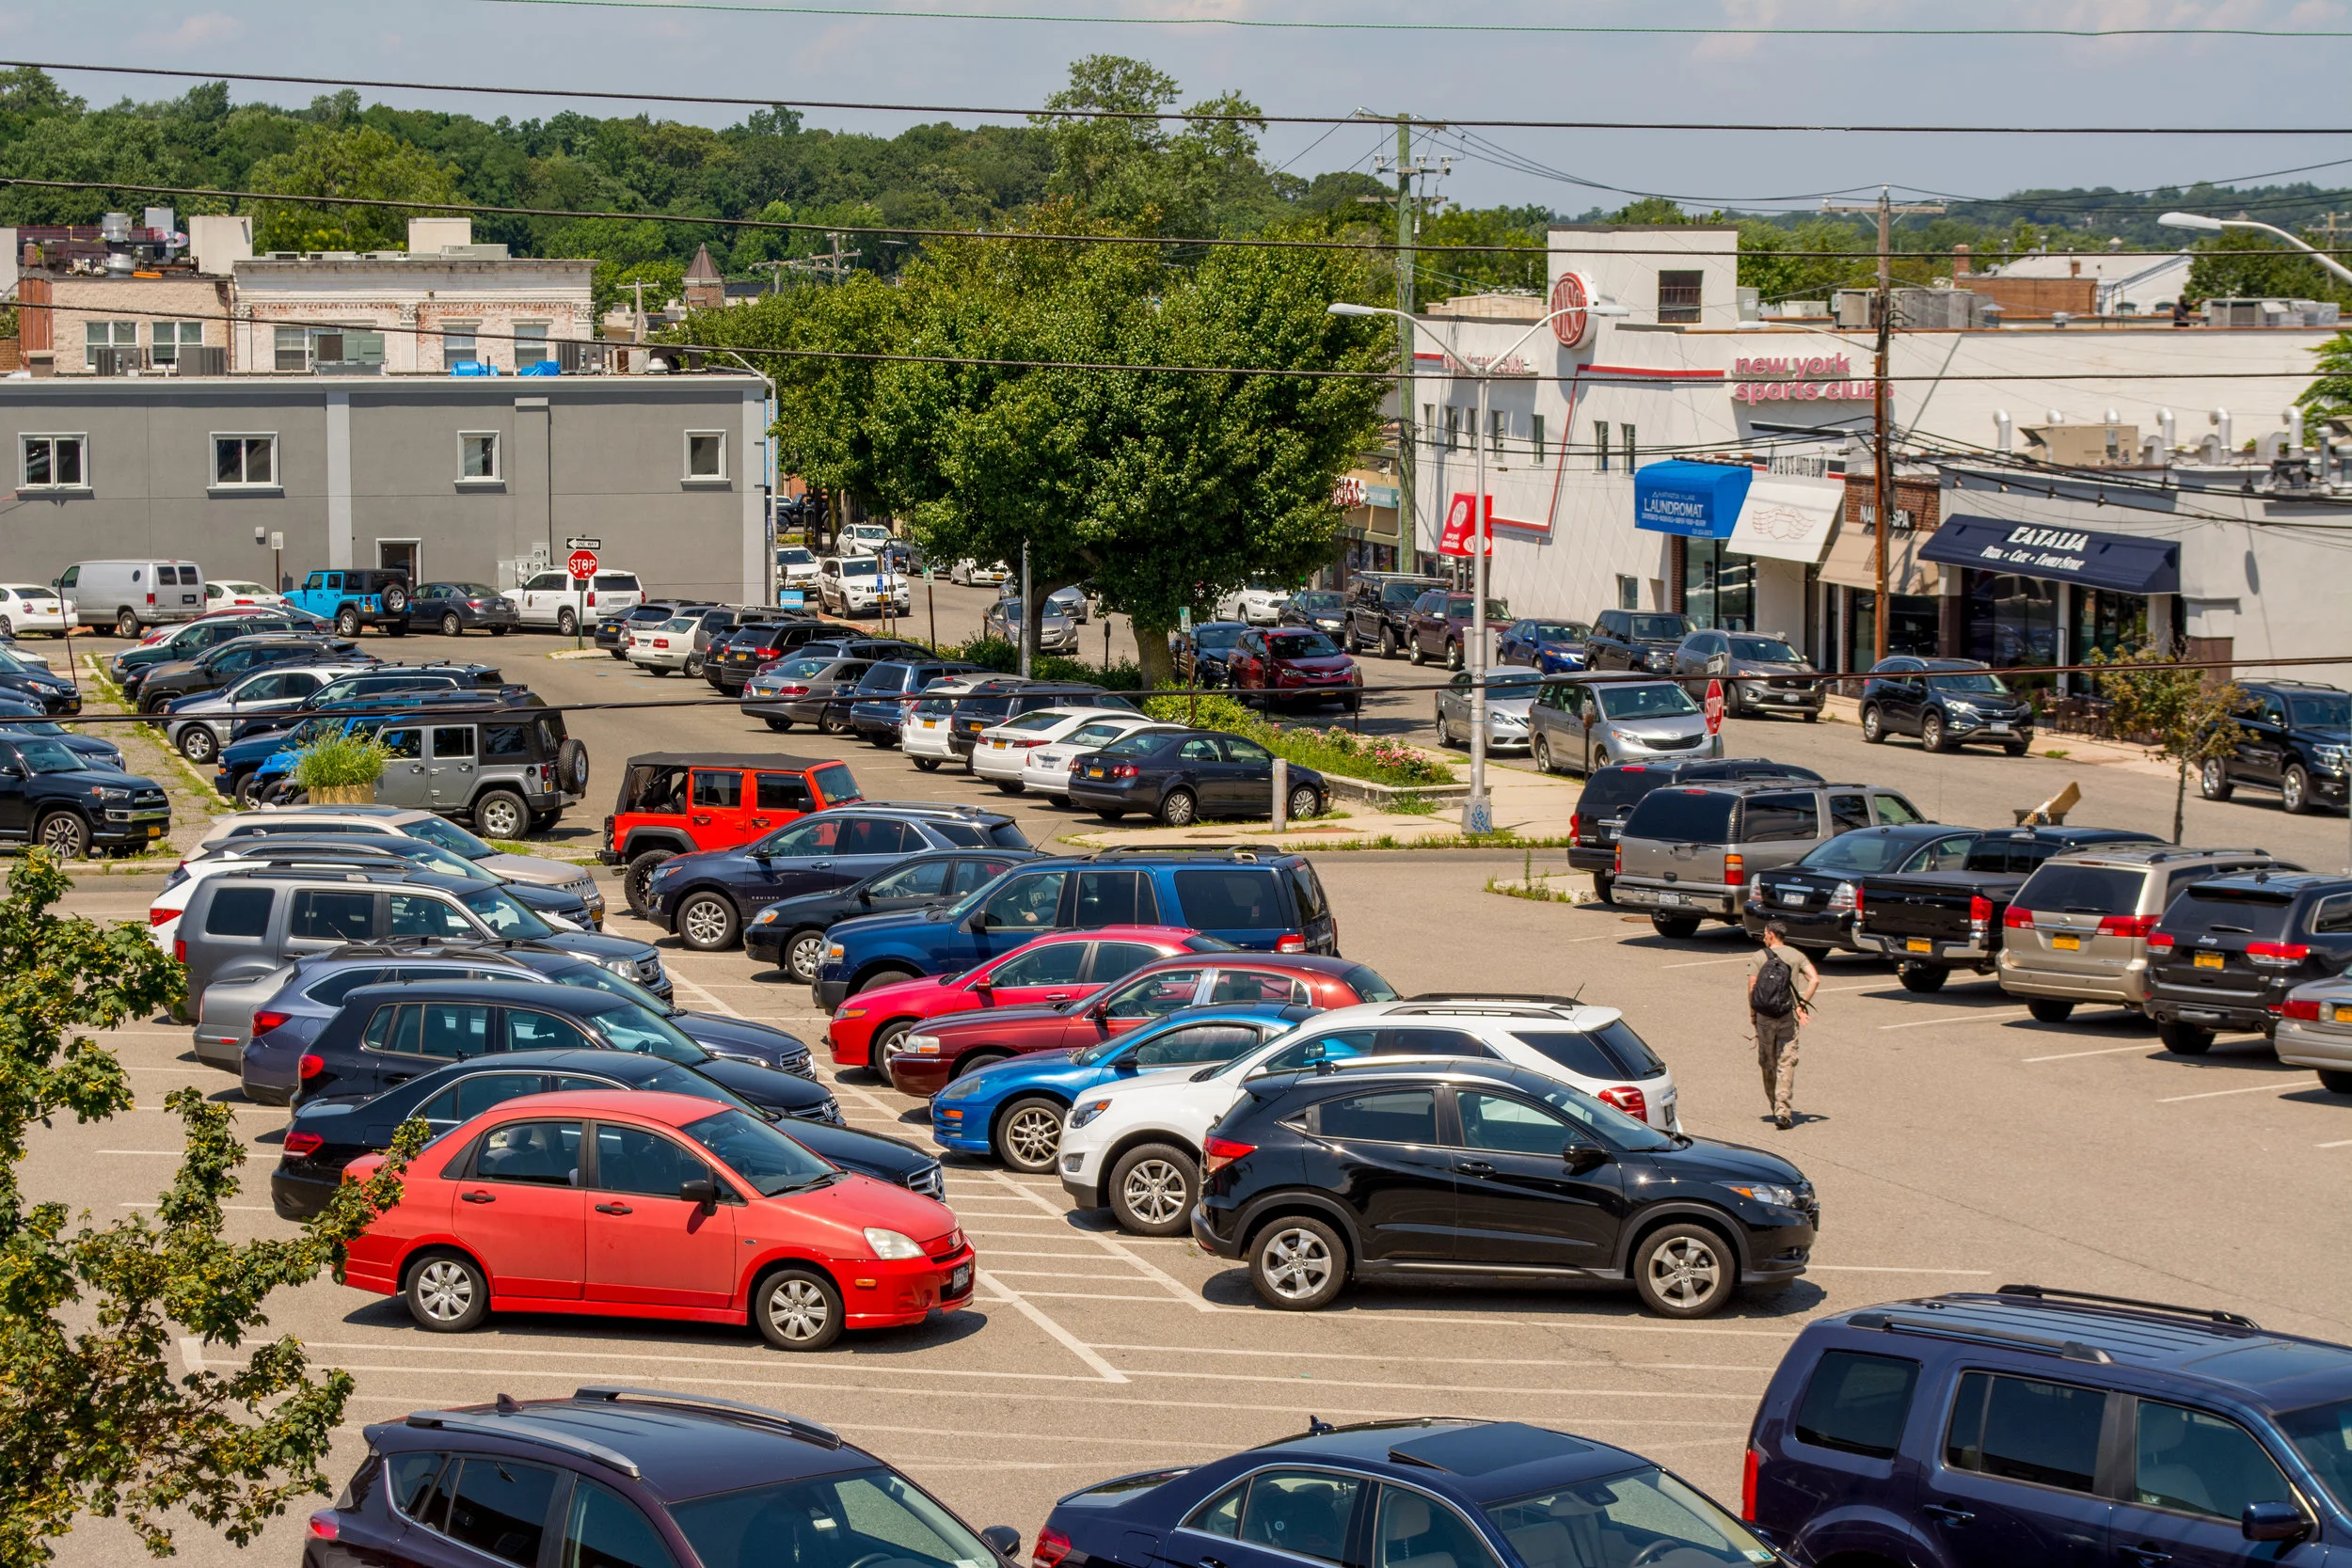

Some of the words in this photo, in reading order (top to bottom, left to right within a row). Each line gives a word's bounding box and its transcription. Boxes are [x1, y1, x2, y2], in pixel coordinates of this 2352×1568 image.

[1735, 357, 1788, 373] new
[1793, 353, 1851, 378] york
[1735, 380, 1819, 405] sports
[1644, 498, 1704, 517] LAUNDROMAT
[1860, 505, 1877, 523] NAI
[1892, 510, 1910, 528] SPA
[2007, 526, 2089, 552] EATALIA
[570, 559, 596, 571] STOP
[1706, 695, 1721, 719] STOP
[2198, 935, 2218, 945] Jeep
